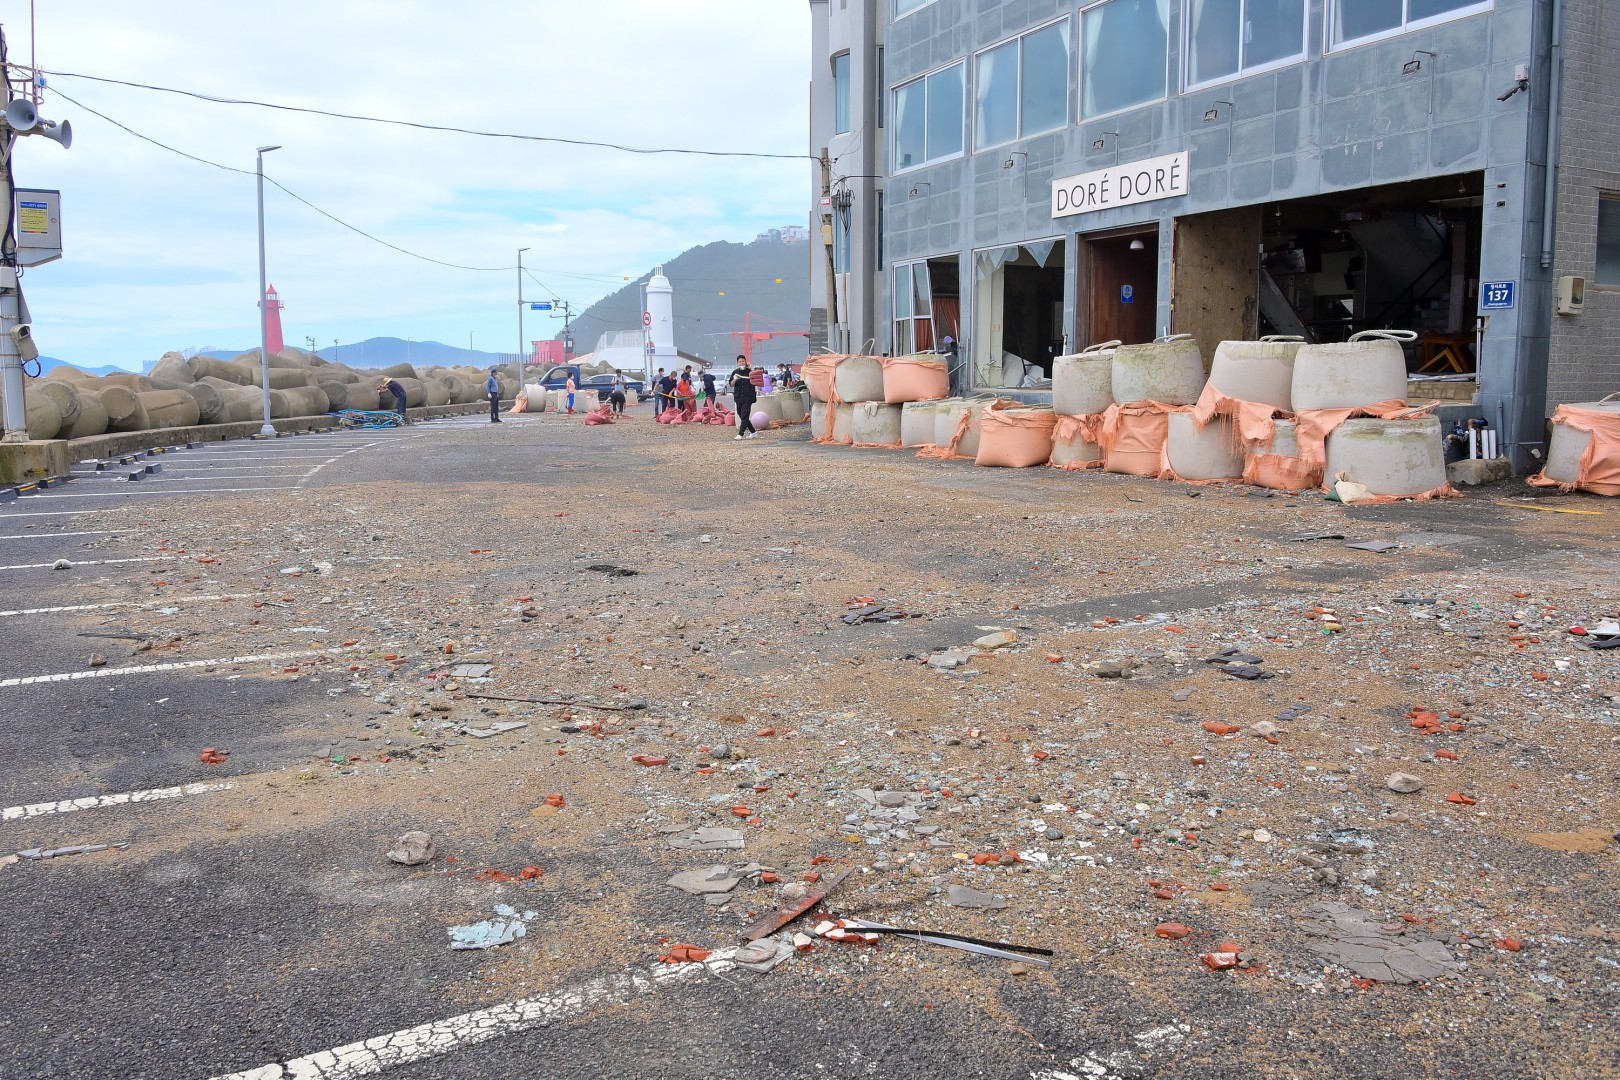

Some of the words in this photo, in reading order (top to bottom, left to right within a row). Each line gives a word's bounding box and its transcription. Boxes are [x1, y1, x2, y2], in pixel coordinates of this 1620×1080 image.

[1057, 173, 1109, 211] DORÉ
[1120, 158, 1180, 200] DORÉ
[1488, 290, 1509, 301] 137
